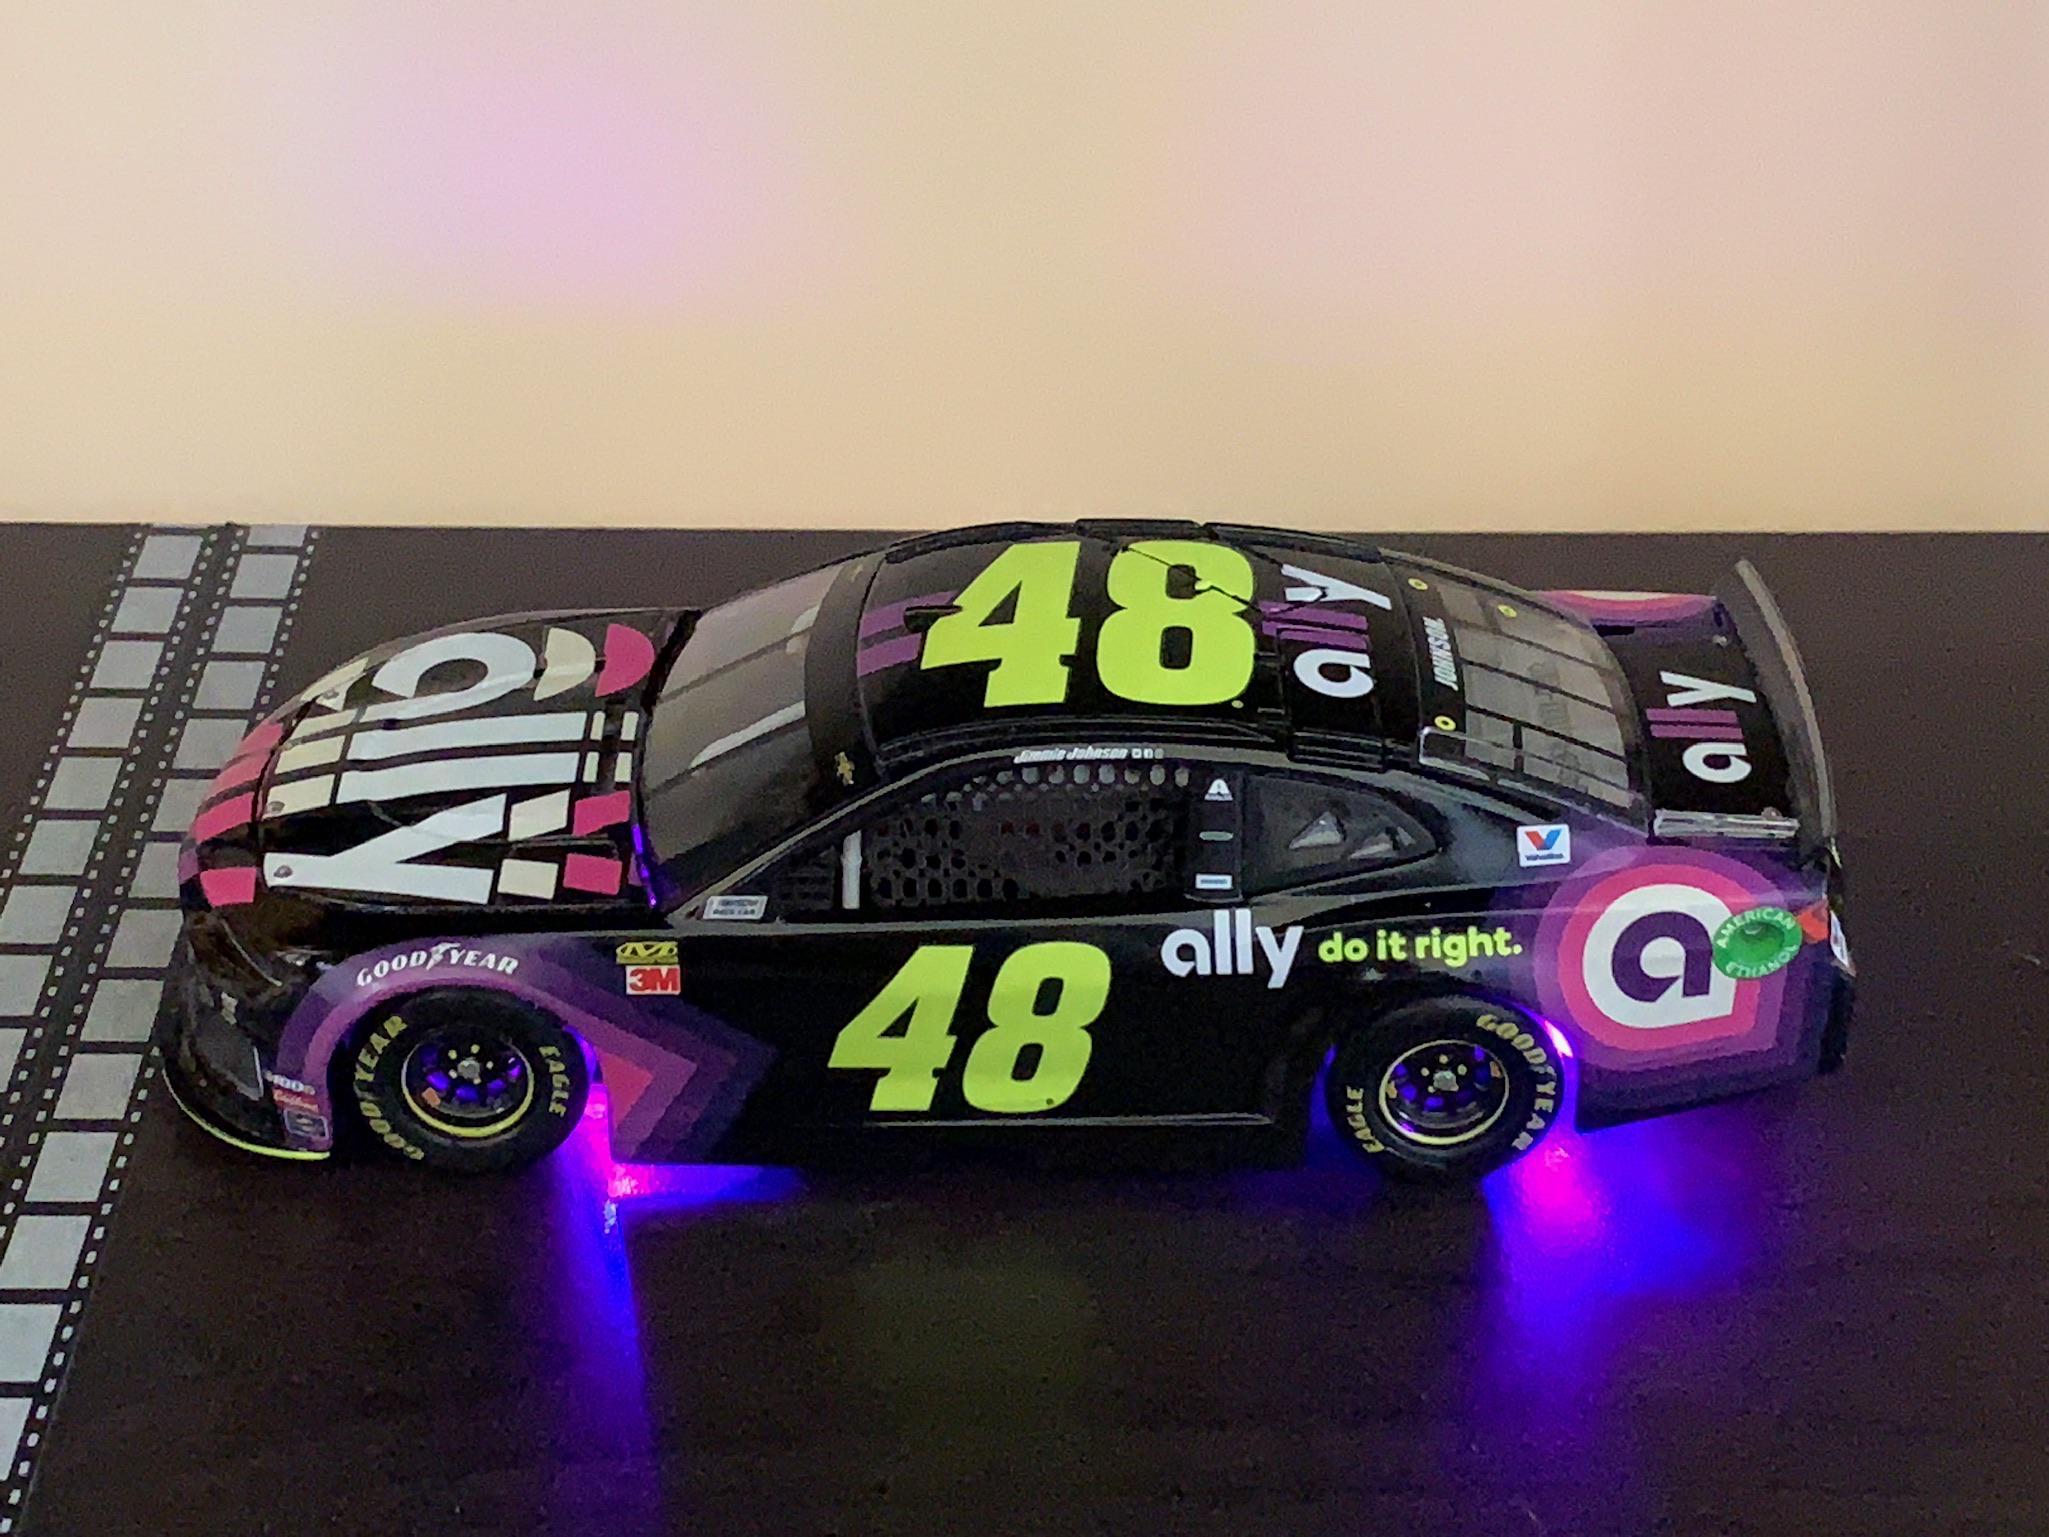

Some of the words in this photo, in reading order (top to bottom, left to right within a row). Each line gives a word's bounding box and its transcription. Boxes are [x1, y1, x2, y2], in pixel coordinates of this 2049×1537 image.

[920, 540, 1255, 708] 48
[1258, 564, 1393, 699] ally
[1645, 670, 1757, 783] ally
[356, 942, 519, 987] GOODYEAR
[1160, 908, 1304, 989] ally
[1318, 932, 1369, 963] do
[1376, 928, 1408, 961] it
[1414, 925, 1523, 967] right.
[1716, 908, 1796, 948] AMERICAN
[1725, 944, 1799, 977] ETHANOL
[629, 967, 680, 992] 3M
[828, 941, 1112, 1113] 48
